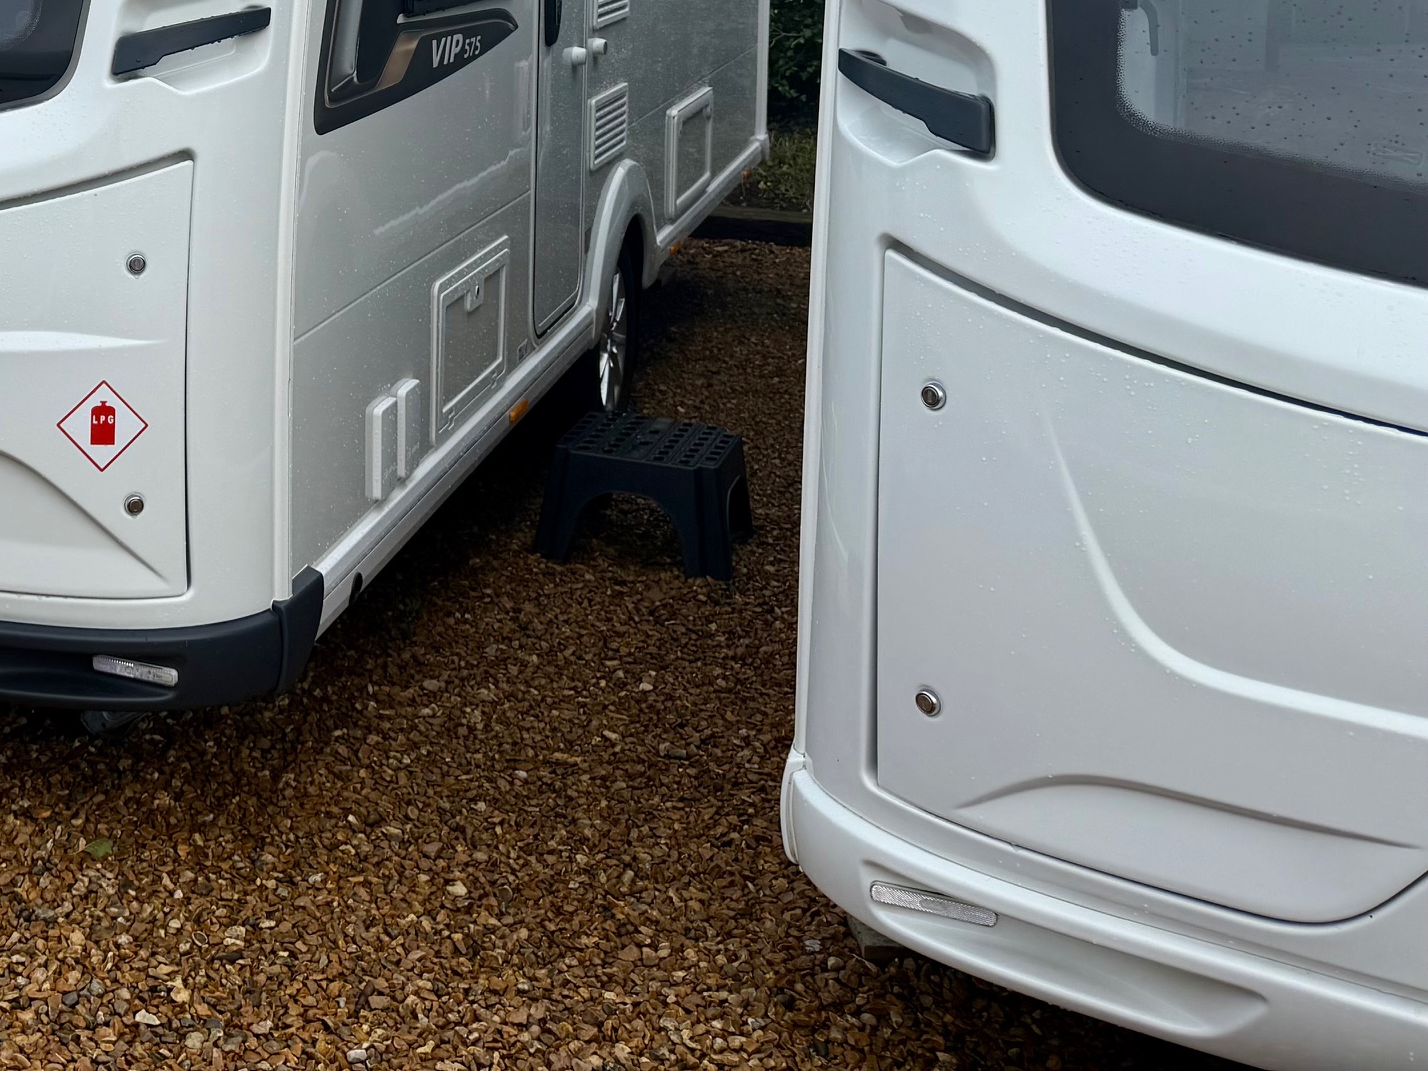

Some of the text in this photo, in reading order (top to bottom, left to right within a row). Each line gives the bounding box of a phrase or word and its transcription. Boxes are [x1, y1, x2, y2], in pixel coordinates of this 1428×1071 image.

[432, 33, 481, 68] VIP 575
[92, 415, 114, 425] LPG
